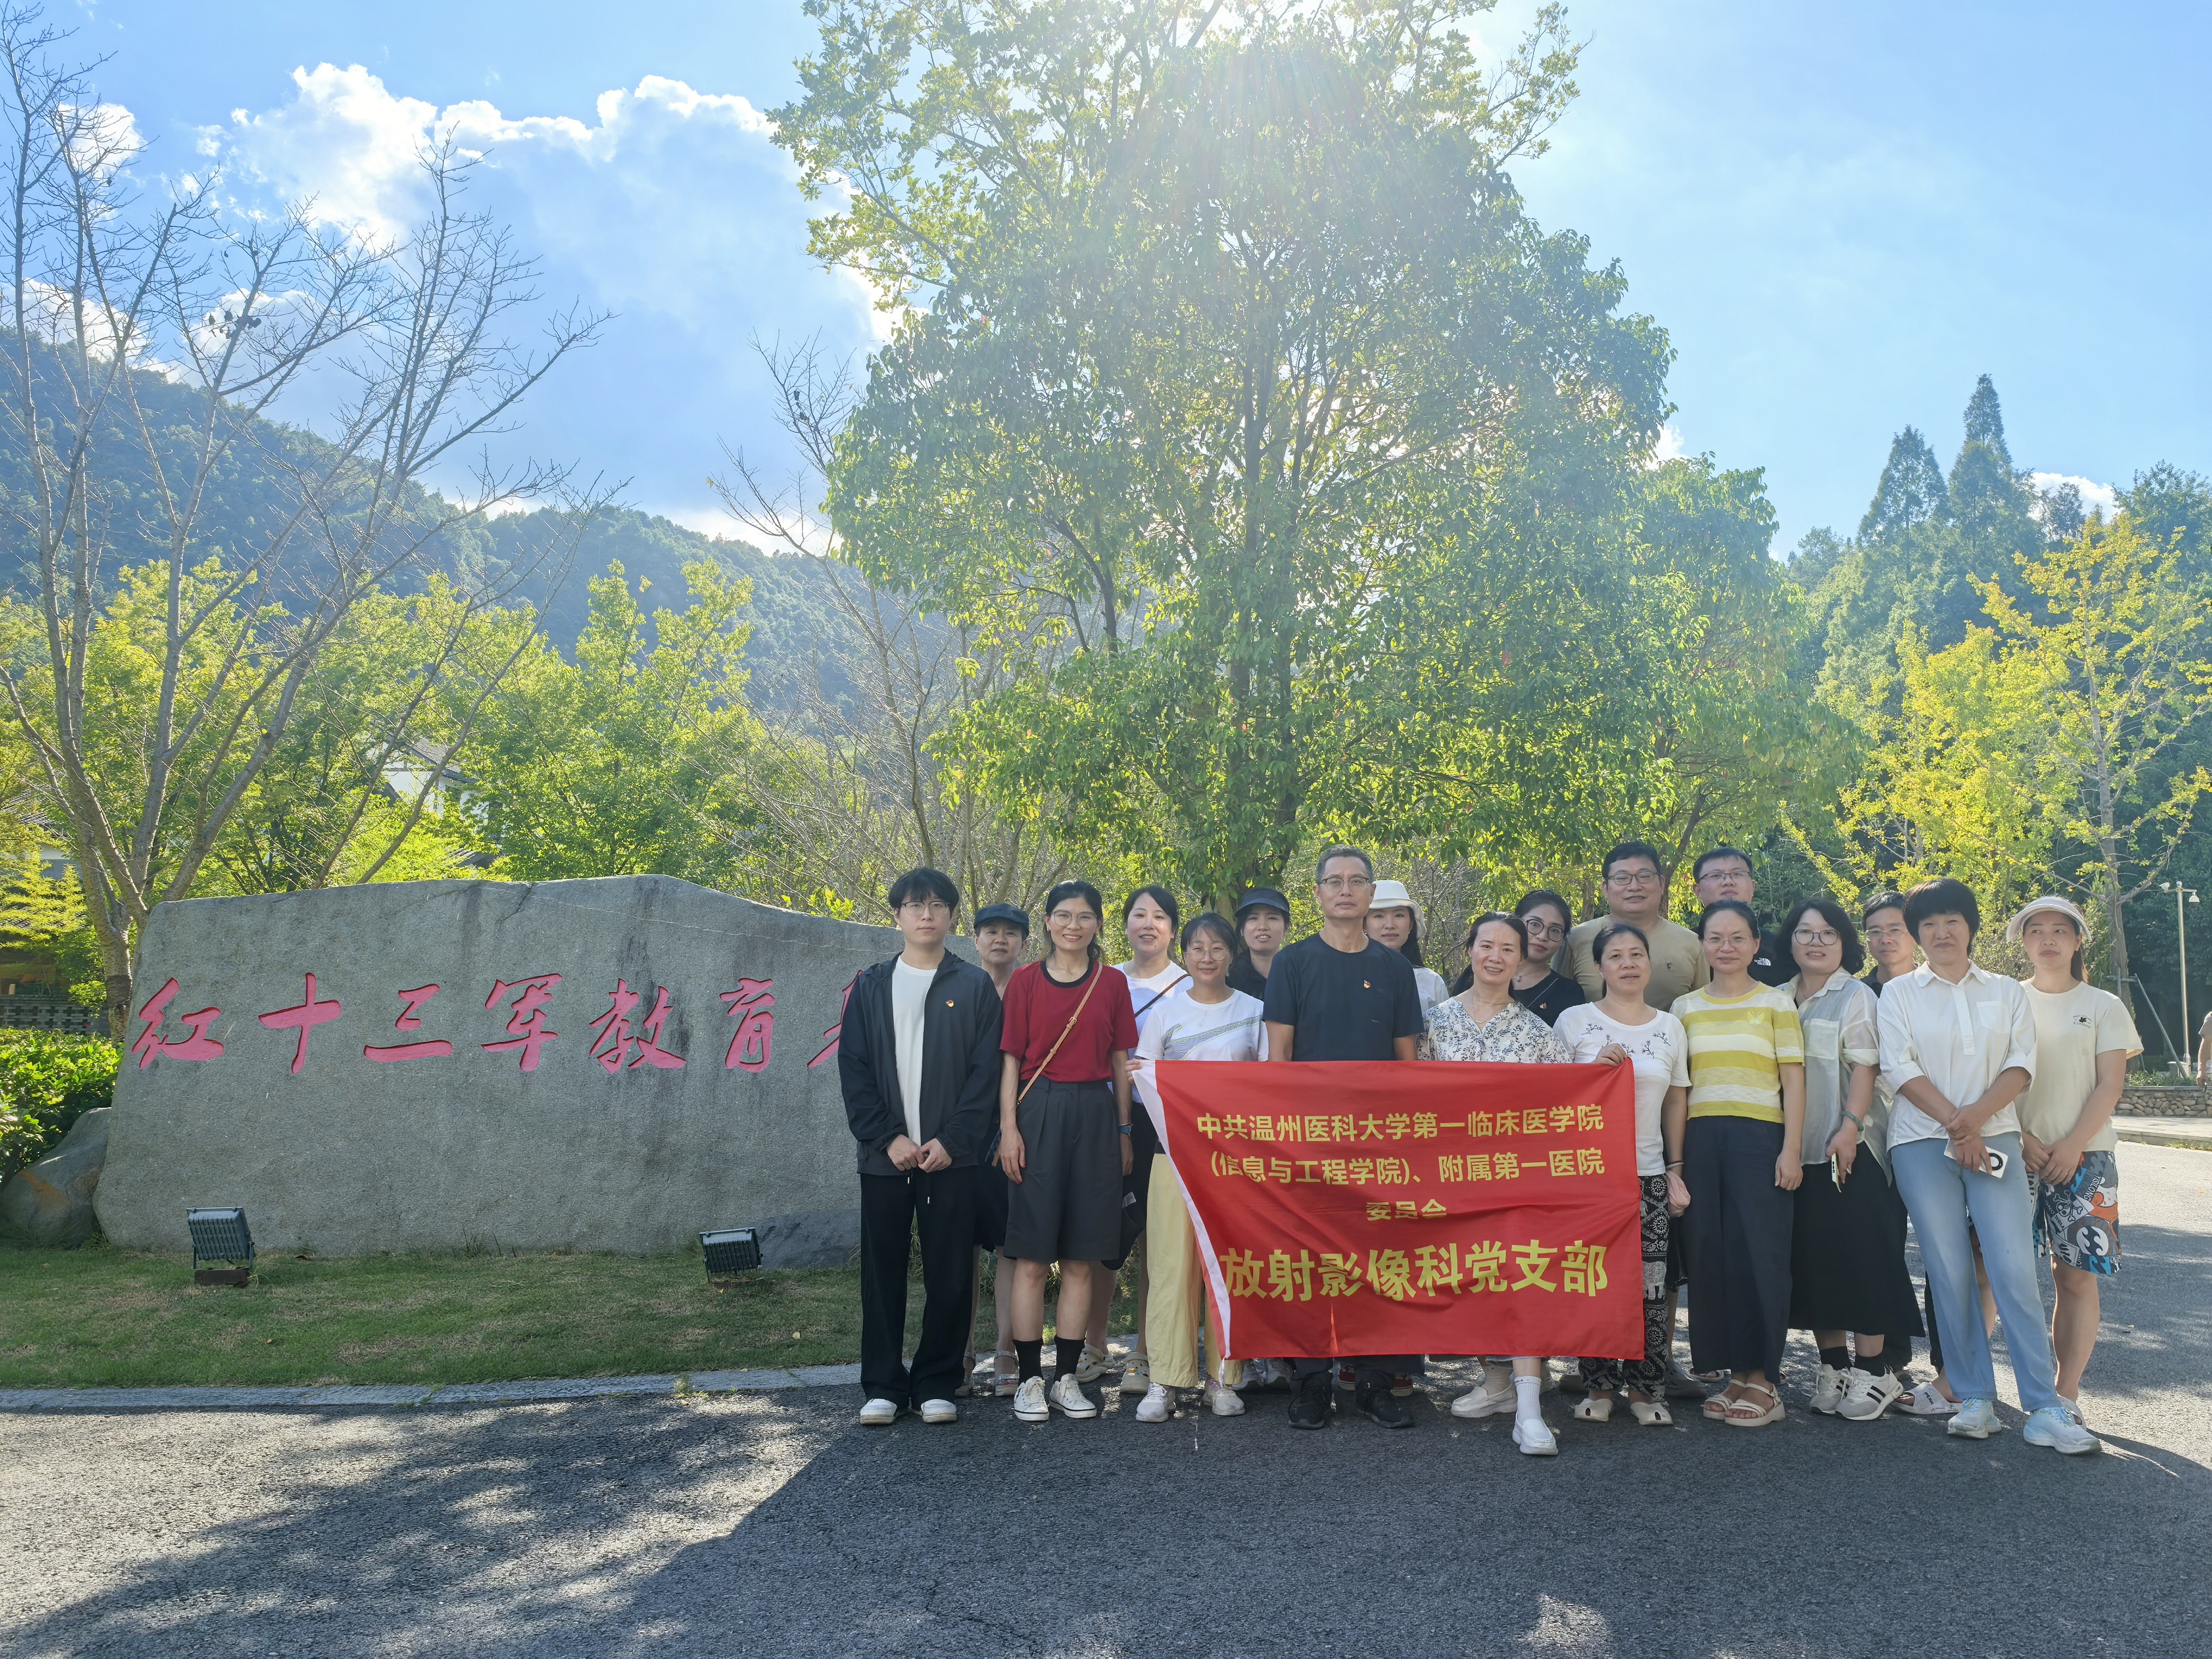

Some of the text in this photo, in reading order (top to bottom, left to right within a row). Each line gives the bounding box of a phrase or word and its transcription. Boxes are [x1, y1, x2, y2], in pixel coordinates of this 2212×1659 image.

[131, 970, 863, 1075] 红十三军教育
[1197, 1103, 1604, 1143] 中共温州医科大学第一临床医学院
[2083, 1175, 2102, 1202] YISILONG
[1366, 1199, 1447, 1221] 委员会
[1220, 1239, 1608, 1302] 放射影像科党支部
